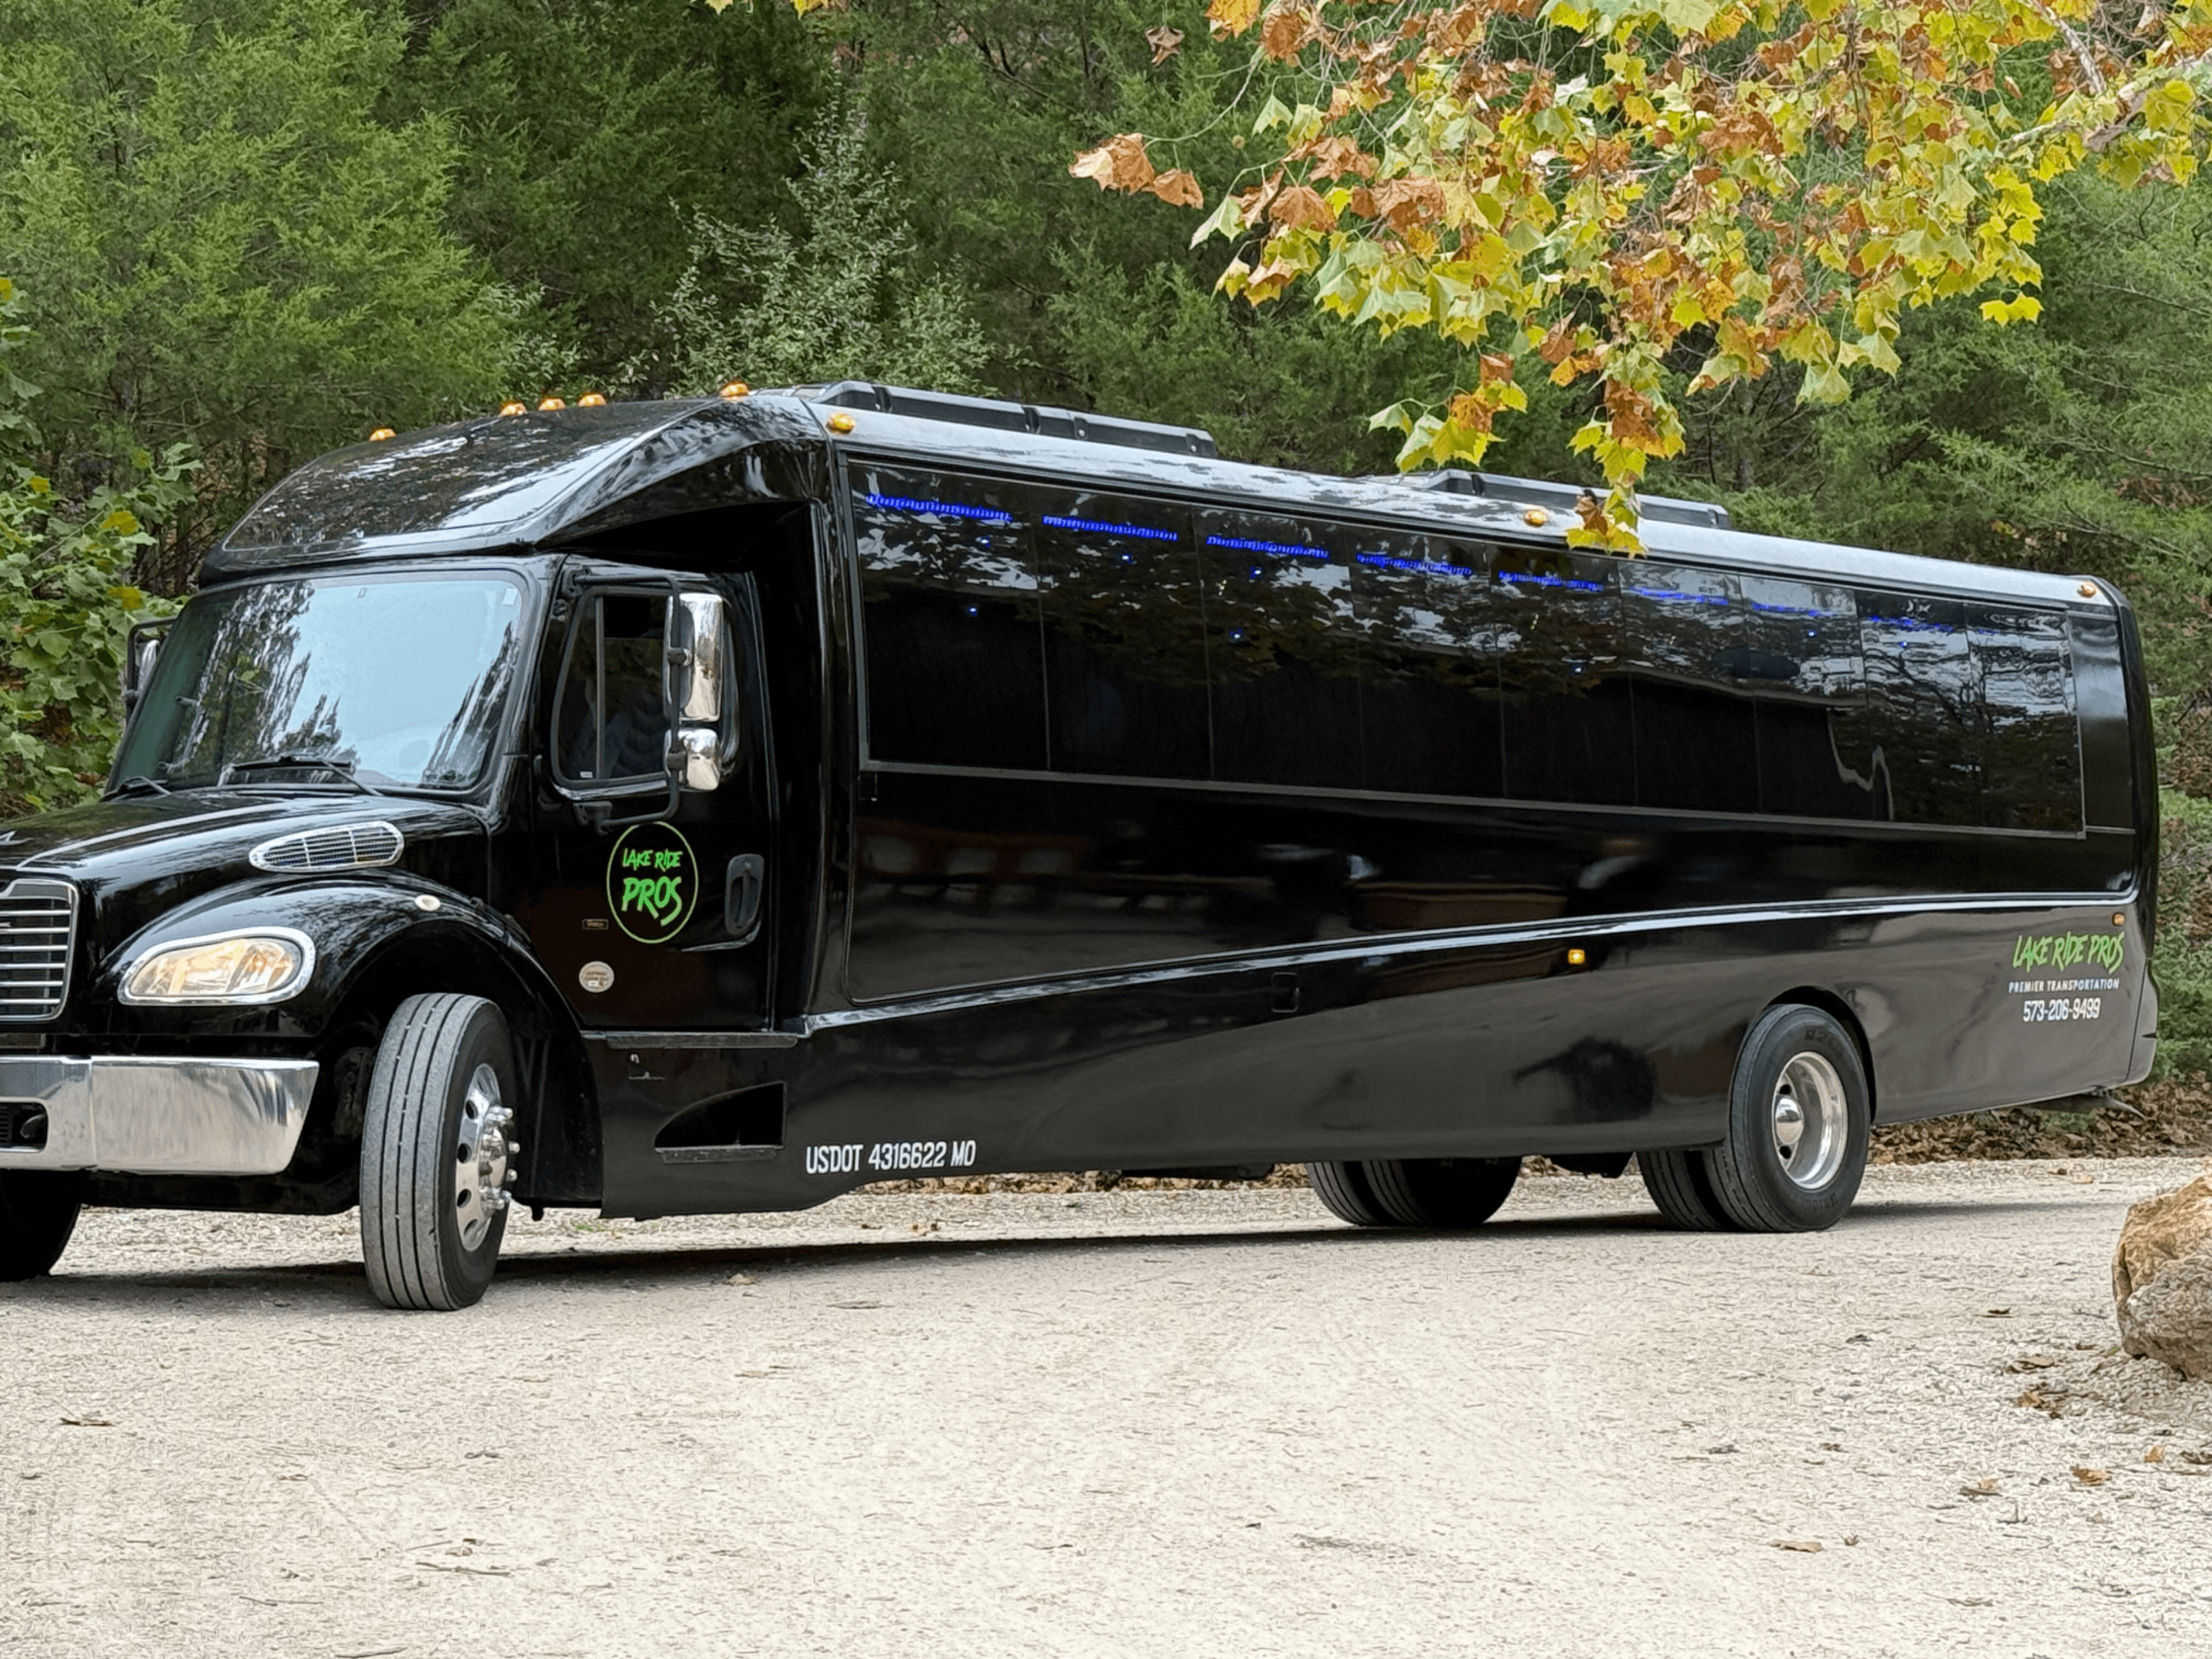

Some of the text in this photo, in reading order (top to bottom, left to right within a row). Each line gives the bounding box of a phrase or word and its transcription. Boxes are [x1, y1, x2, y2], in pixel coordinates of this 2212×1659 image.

[622, 848, 683, 872] LAKE RIDE
[622, 876, 682, 927] PROS
[2013, 931, 2124, 975] LAKE RIDE PROS
[2009, 978, 2120, 994] PREMIER TRANSPORTATION
[2022, 997, 2101, 1022] 573-206-9499
[806, 1139, 976, 1174] USDOT 4316622 MO
